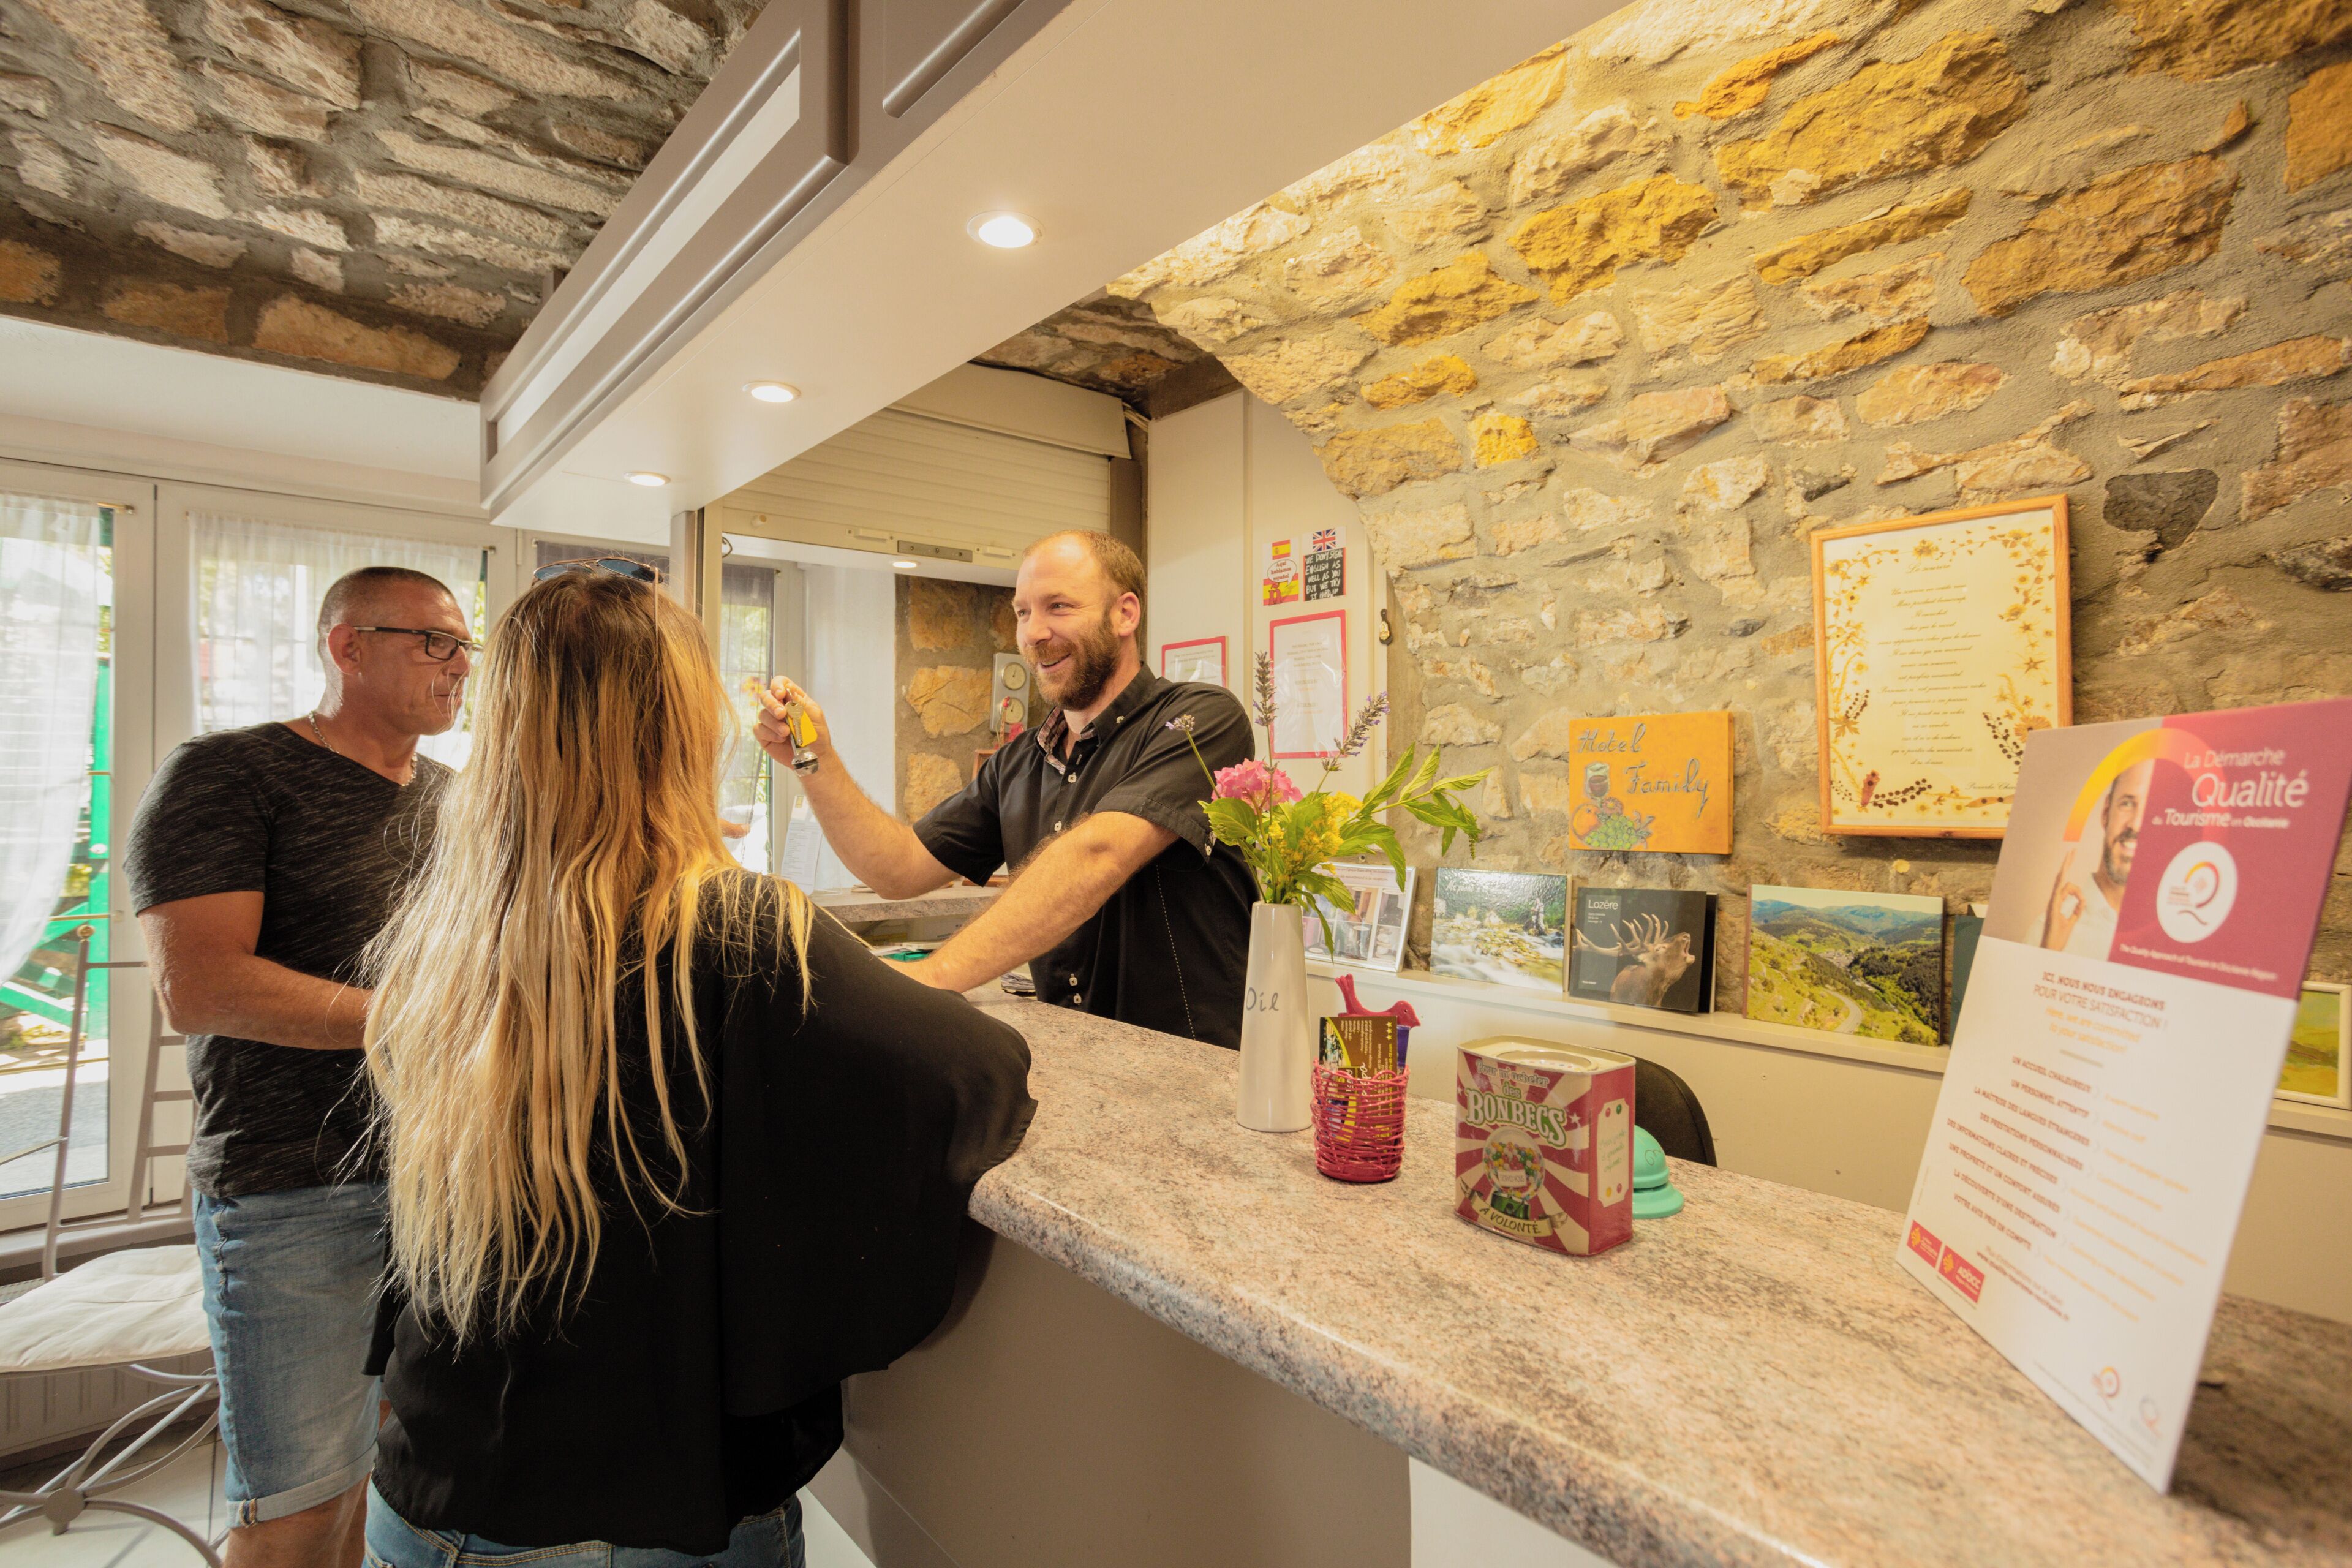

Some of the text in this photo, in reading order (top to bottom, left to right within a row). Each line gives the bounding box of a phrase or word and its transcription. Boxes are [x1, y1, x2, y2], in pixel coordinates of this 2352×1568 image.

[1305, 555, 1313, 565] WE
[1305, 560, 1341, 575] ENGLISH AS
[1308, 569, 1341, 583] WELL AS YOU
[1306, 578, 1341, 594] BUT WE TRY
[1578, 723, 1646, 753] Hotel
[2184, 747, 2286, 769] La Démarche
[1625, 758, 1709, 819] Family
[2192, 769, 2309, 808] Qualité
[2164, 808, 2232, 827] Tourisme
[1588, 899, 1618, 910] Lozère
[2057, 976, 2081, 989] NOUS
[2081, 982, 2106, 995] NOUS
[1245, 987, 1279, 1012] Oil
[2034, 984, 2057, 1000] POUR
[2059, 991, 2088, 1009] VOTRE
[2089, 999, 2160, 1029] SATISFACTION
[1476, 1059, 1497, 1076] Pour
[1503, 1081, 1521, 1099] des
[1466, 1087, 1567, 1148] BONBECS
[1490, 1212, 1542, 1234] VOLONTÉ
